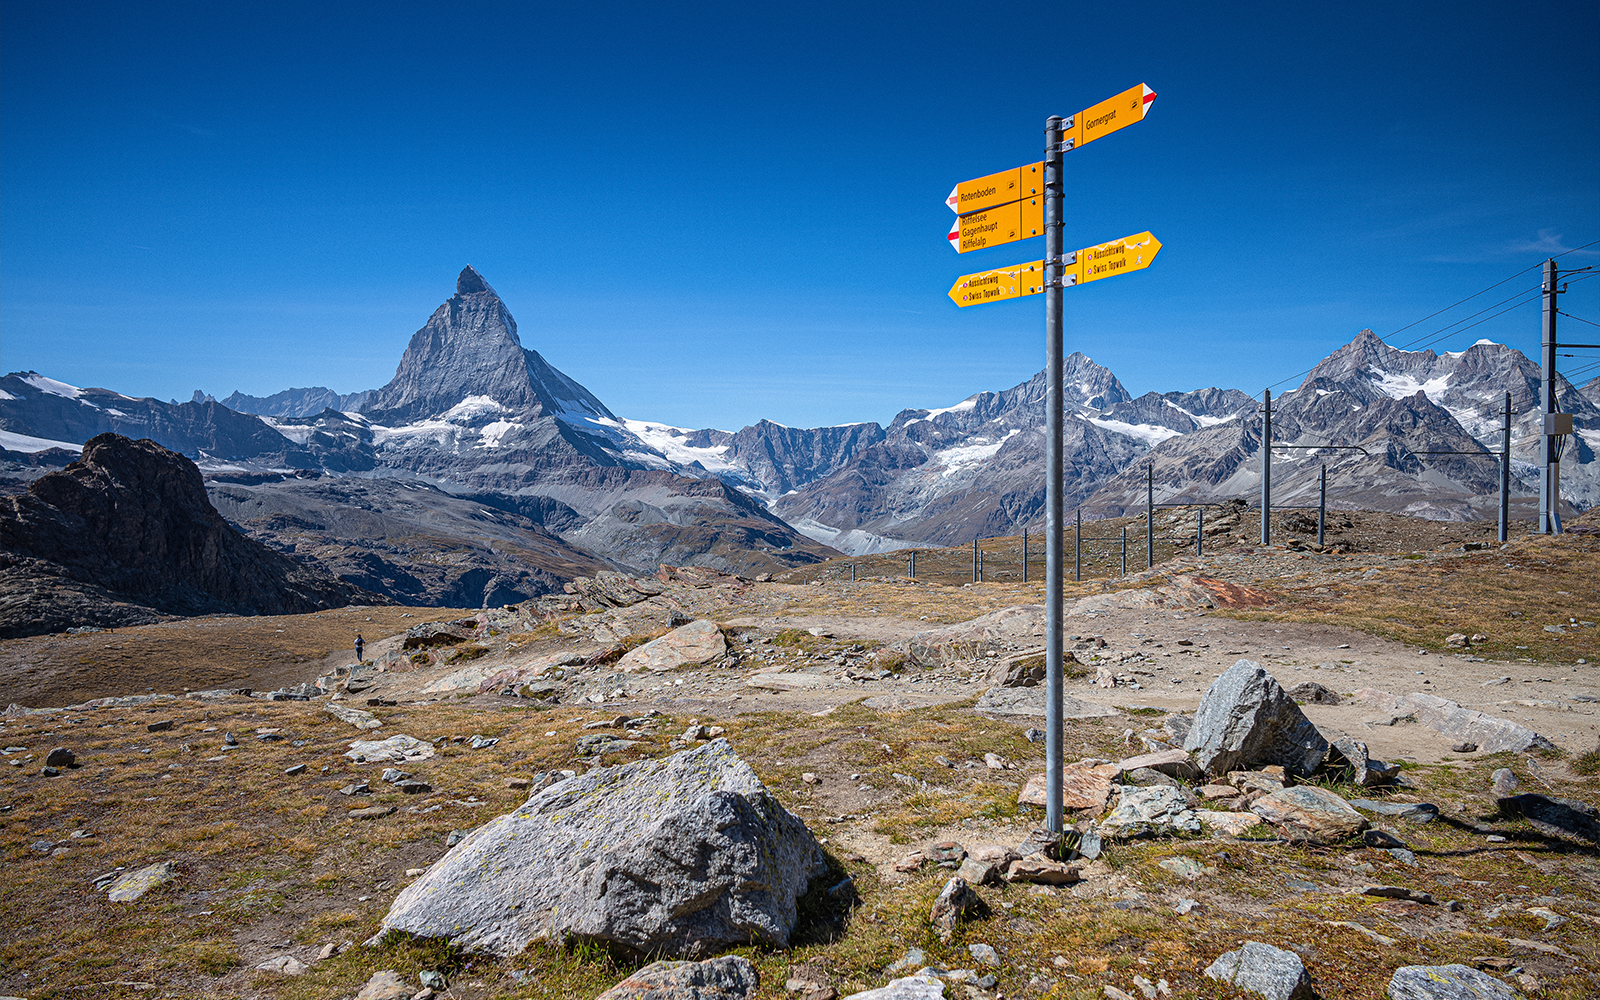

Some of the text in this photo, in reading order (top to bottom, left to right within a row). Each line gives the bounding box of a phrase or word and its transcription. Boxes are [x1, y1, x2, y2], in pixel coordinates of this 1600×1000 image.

[1086, 109, 1116, 130] Gornergrat
[961, 186, 996, 202] Rotenboden
[962, 221, 998, 238] Gagenhaupt
[963, 237, 987, 249] Riffelalp
[1093, 245, 1125, 260] Aussichtsweg
[1093, 263, 1107, 274] Swiss
[1108, 257, 1126, 271] Topwalk
[968, 276, 999, 288] Aussichtsweg
[968, 291, 982, 301] Swiss
[983, 287, 1000, 299] Topwalk
